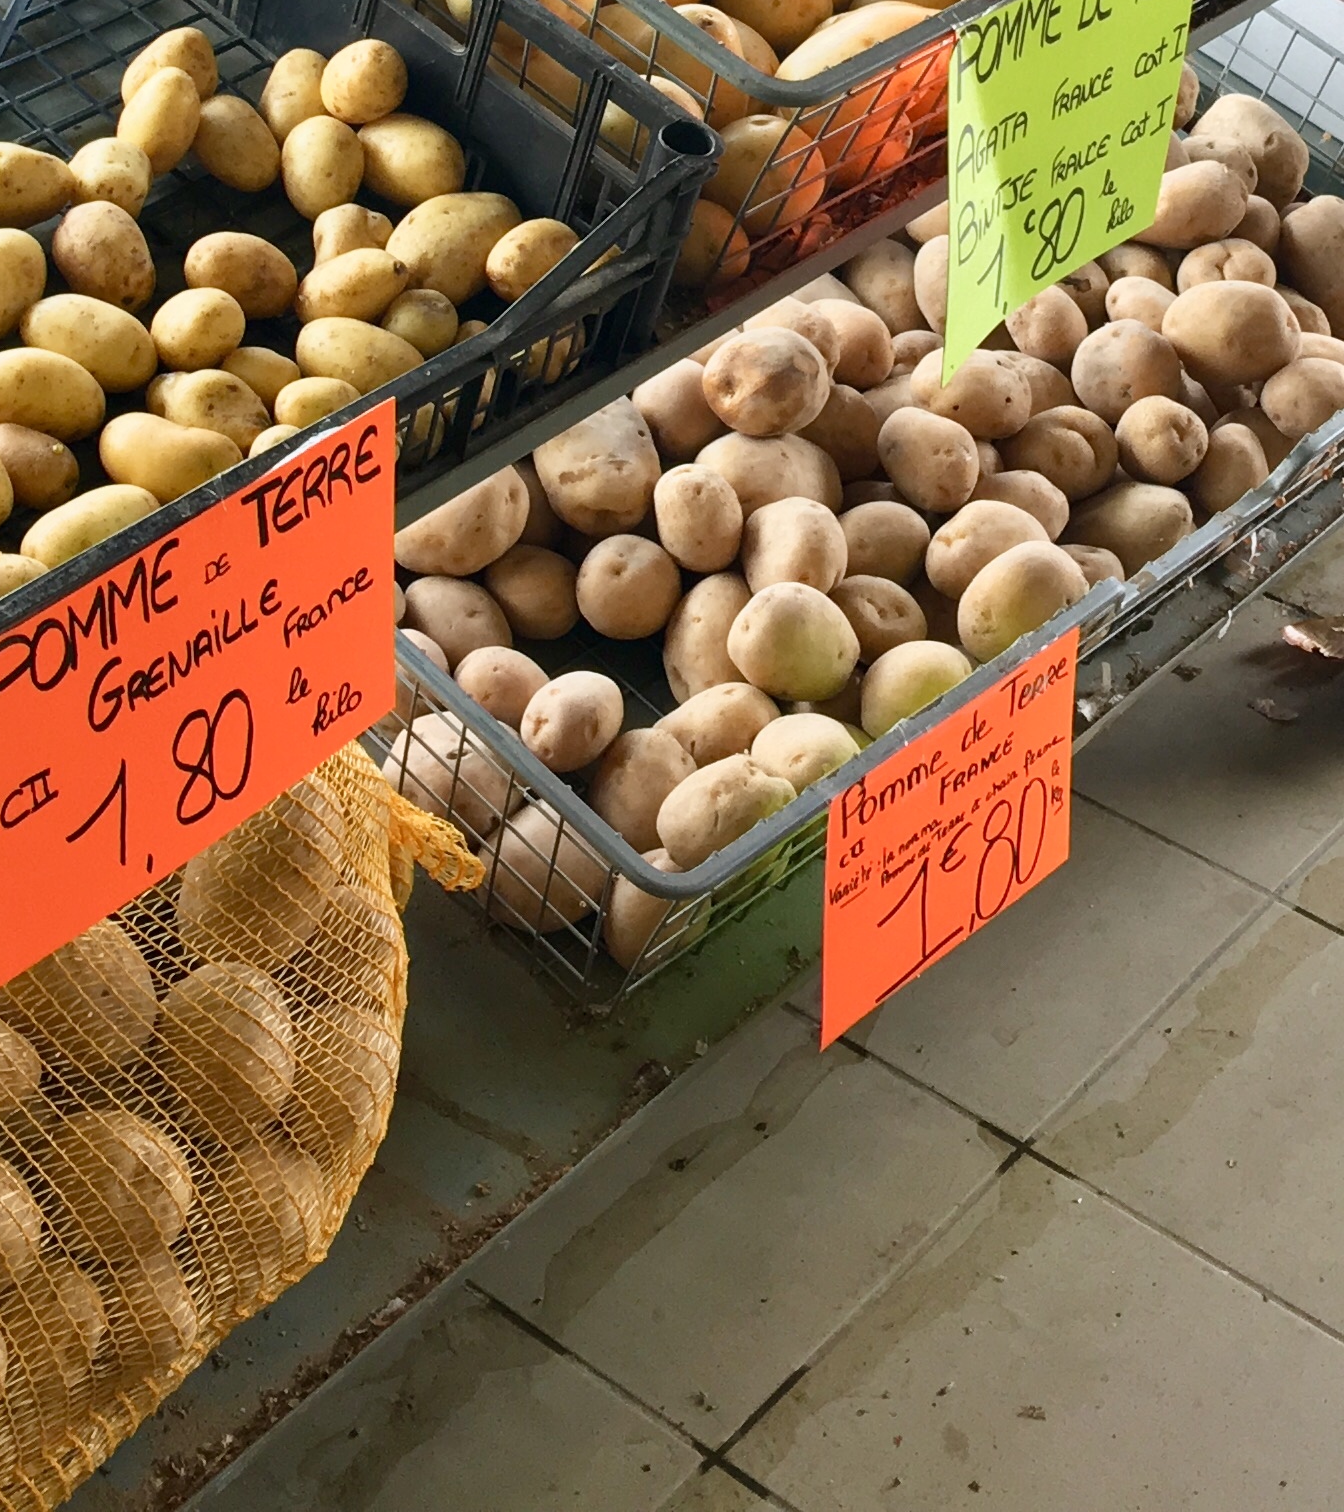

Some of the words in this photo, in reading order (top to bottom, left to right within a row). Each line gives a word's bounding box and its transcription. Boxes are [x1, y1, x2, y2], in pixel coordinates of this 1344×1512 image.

[955, 110, 1029, 203] AGATA
[1051, 65, 1113, 122] FRANCE
[1050, 133, 1109, 190] FRANCE
[203, 551, 232, 586] DE
[241, 423, 383, 548] TERRE
[284, 665, 314, 706] le
[312, 681, 364, 738] kilo
[841, 746, 949, 840] Pomme
[960, 709, 994, 754] de
[939, 731, 1016, 806] FRANCE
